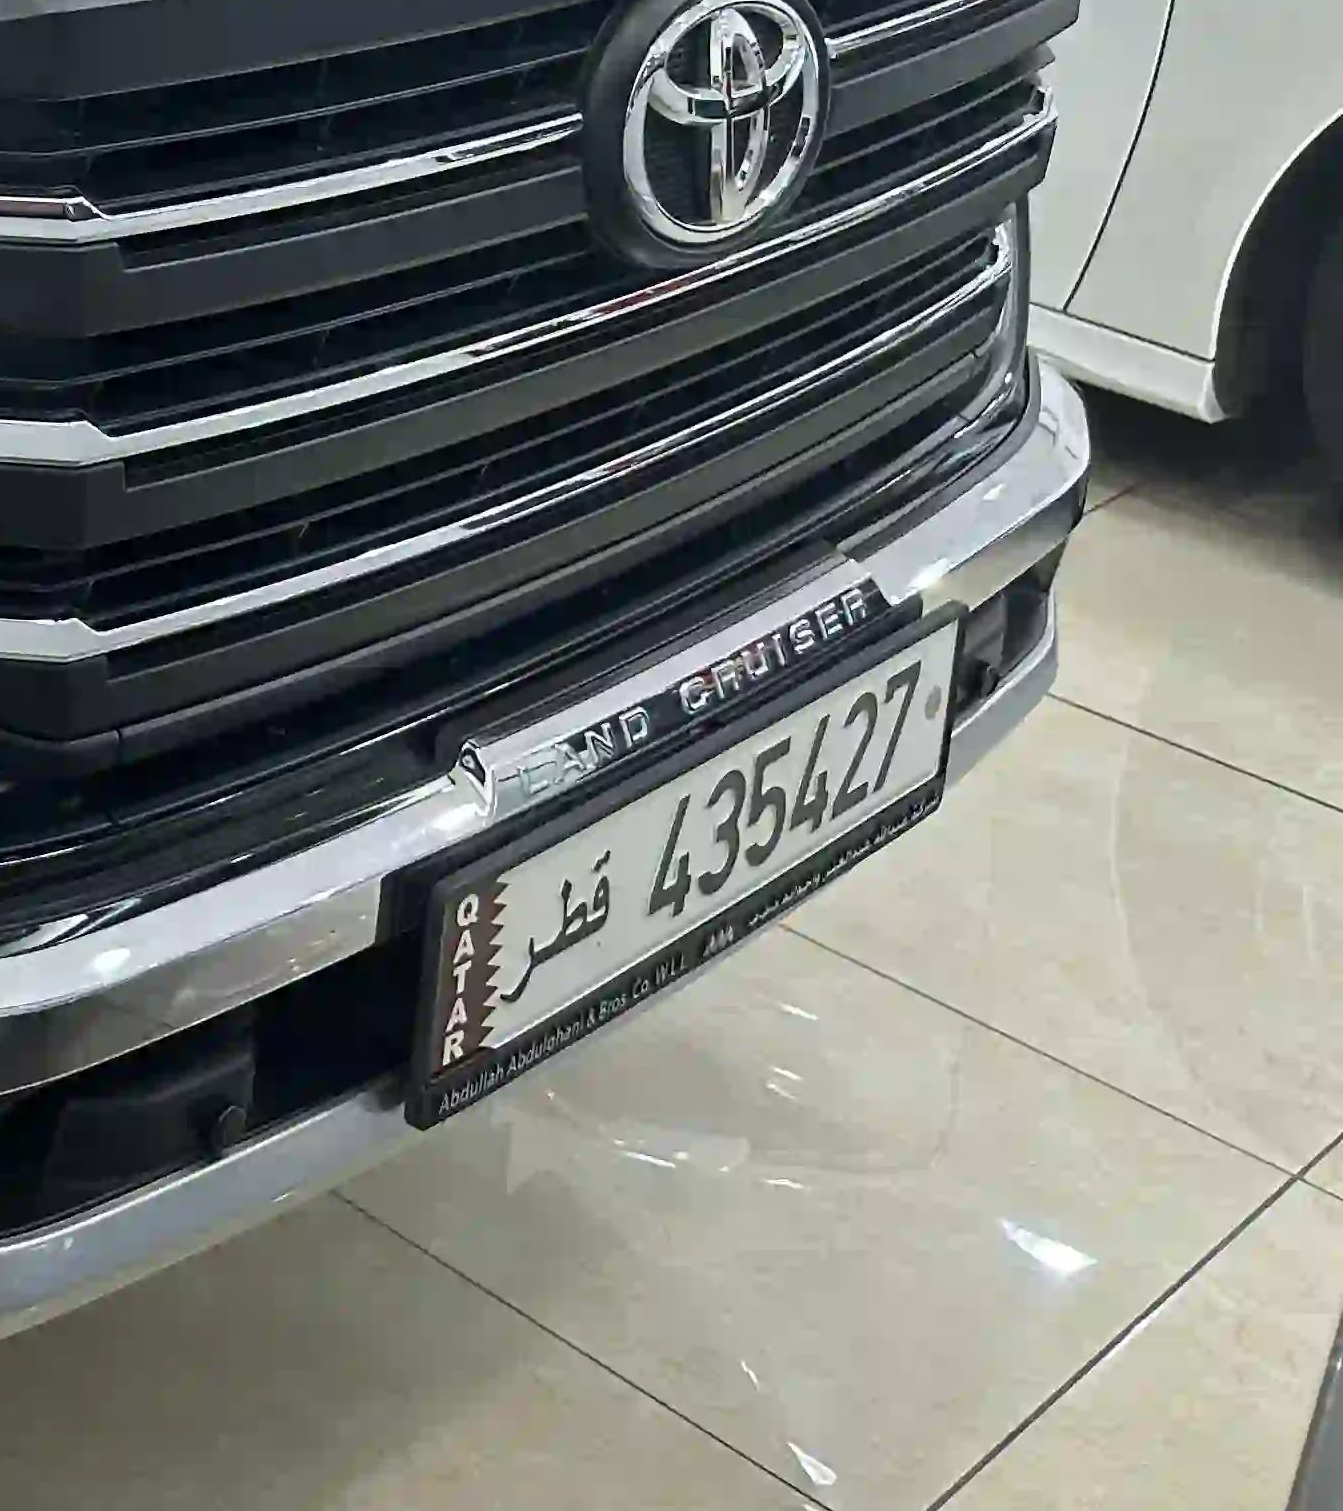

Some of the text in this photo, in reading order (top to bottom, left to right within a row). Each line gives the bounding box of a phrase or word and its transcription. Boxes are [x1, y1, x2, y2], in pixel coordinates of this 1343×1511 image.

[518, 587, 870, 797] LAND CRUISER
[647, 659, 922, 919] 435427
[442, 894, 480, 1067] QATAR
[499, 850, 613, 1003] قطر
[438, 1062, 504, 1115] Abdullah
[506, 1014, 585, 1076] Abdulghani
